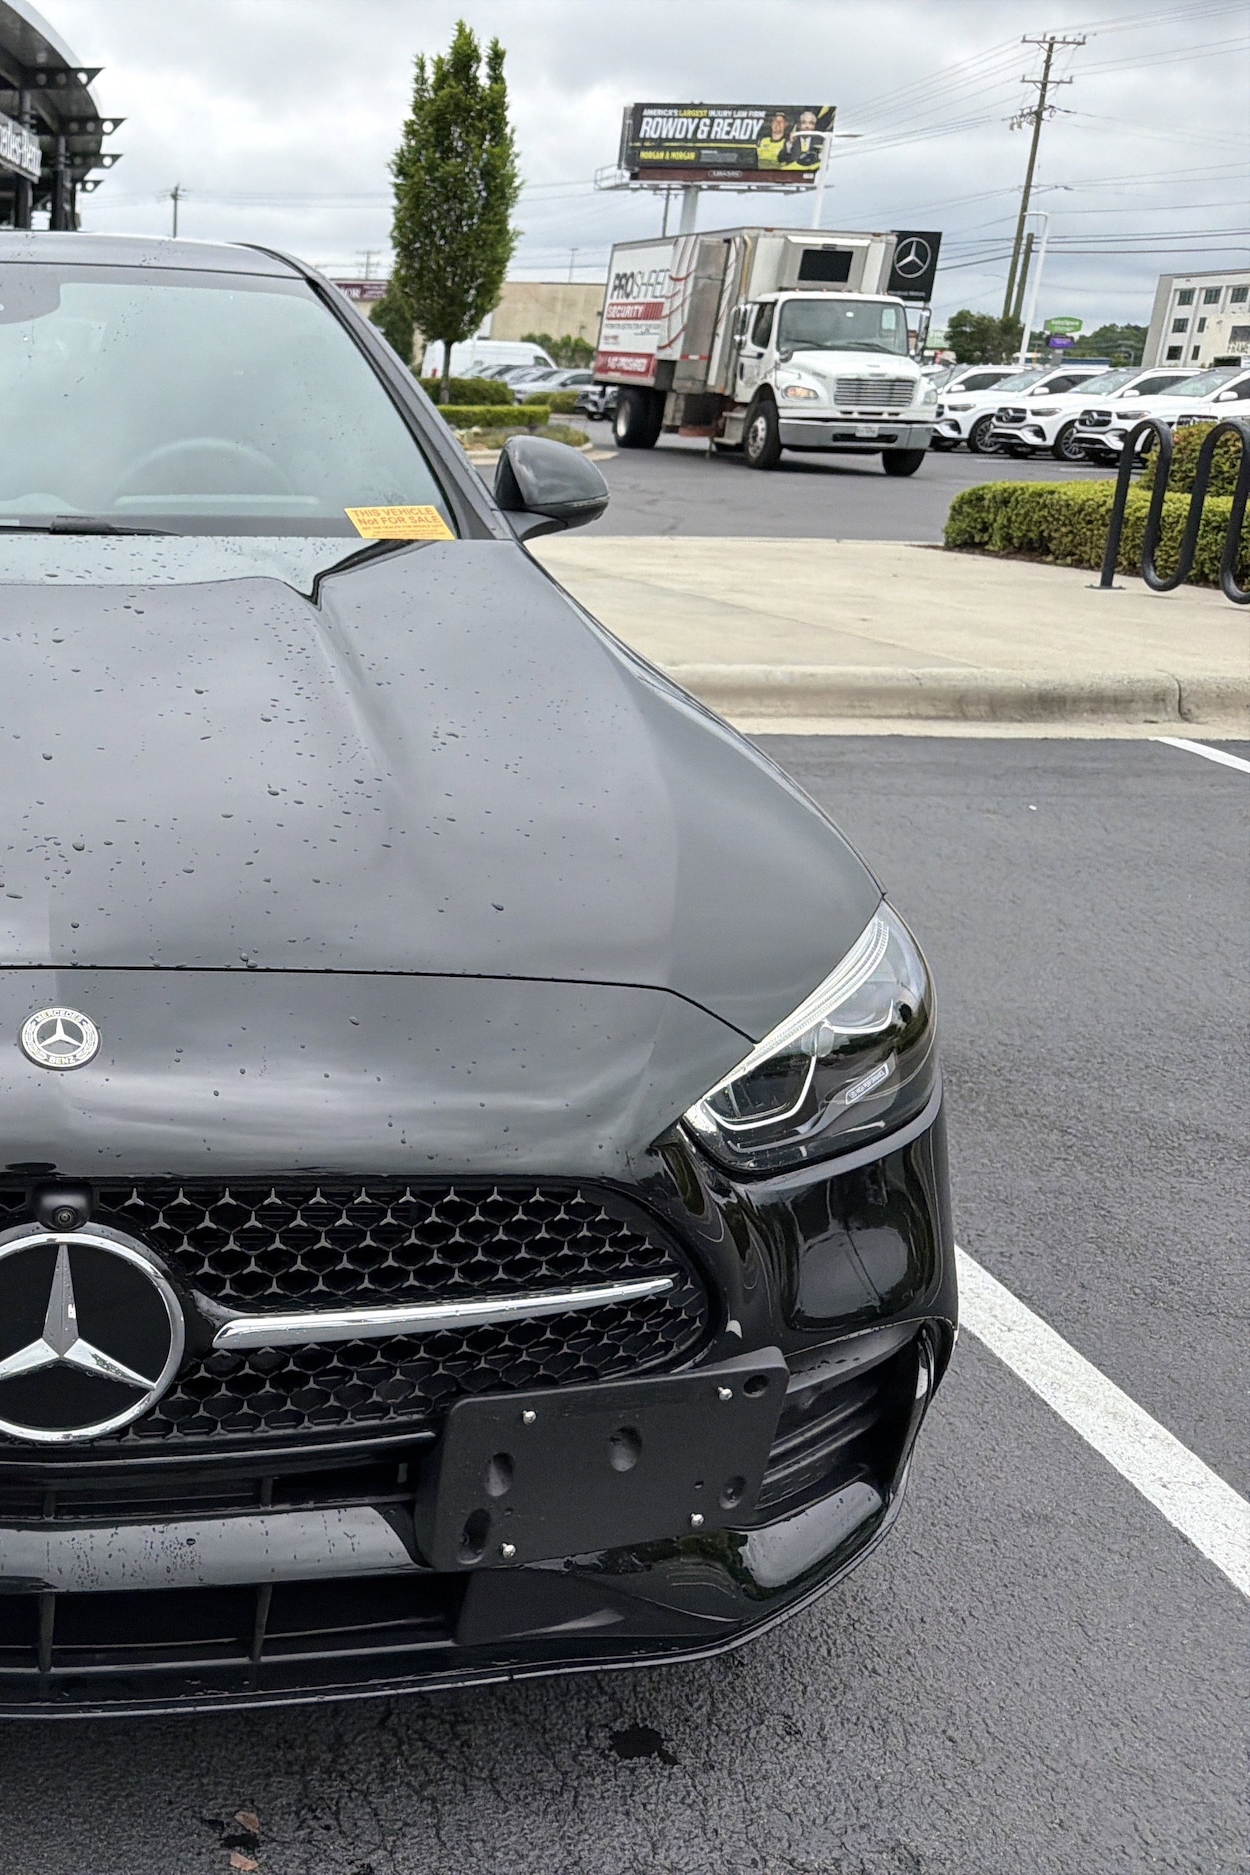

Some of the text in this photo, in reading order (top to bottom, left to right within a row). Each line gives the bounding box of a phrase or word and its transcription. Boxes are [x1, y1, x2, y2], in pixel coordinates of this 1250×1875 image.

[679, 109, 708, 118] LARGEST
[733, 110, 748, 118] LAW
[639, 117, 765, 140] ROWDY & READY
[639, 150, 664, 160] MORGAN
[670, 151, 697, 160] MORGAN
[607, 304, 645, 319] SECURITY
[352, 507, 435, 518] THIS VEHICLE
[381, 517, 406, 525] FOR
[410, 515, 441, 524] SALE
[35, 1010, 81, 1022] MERCEDES
[48, 1057, 76, 1065] BENZ
